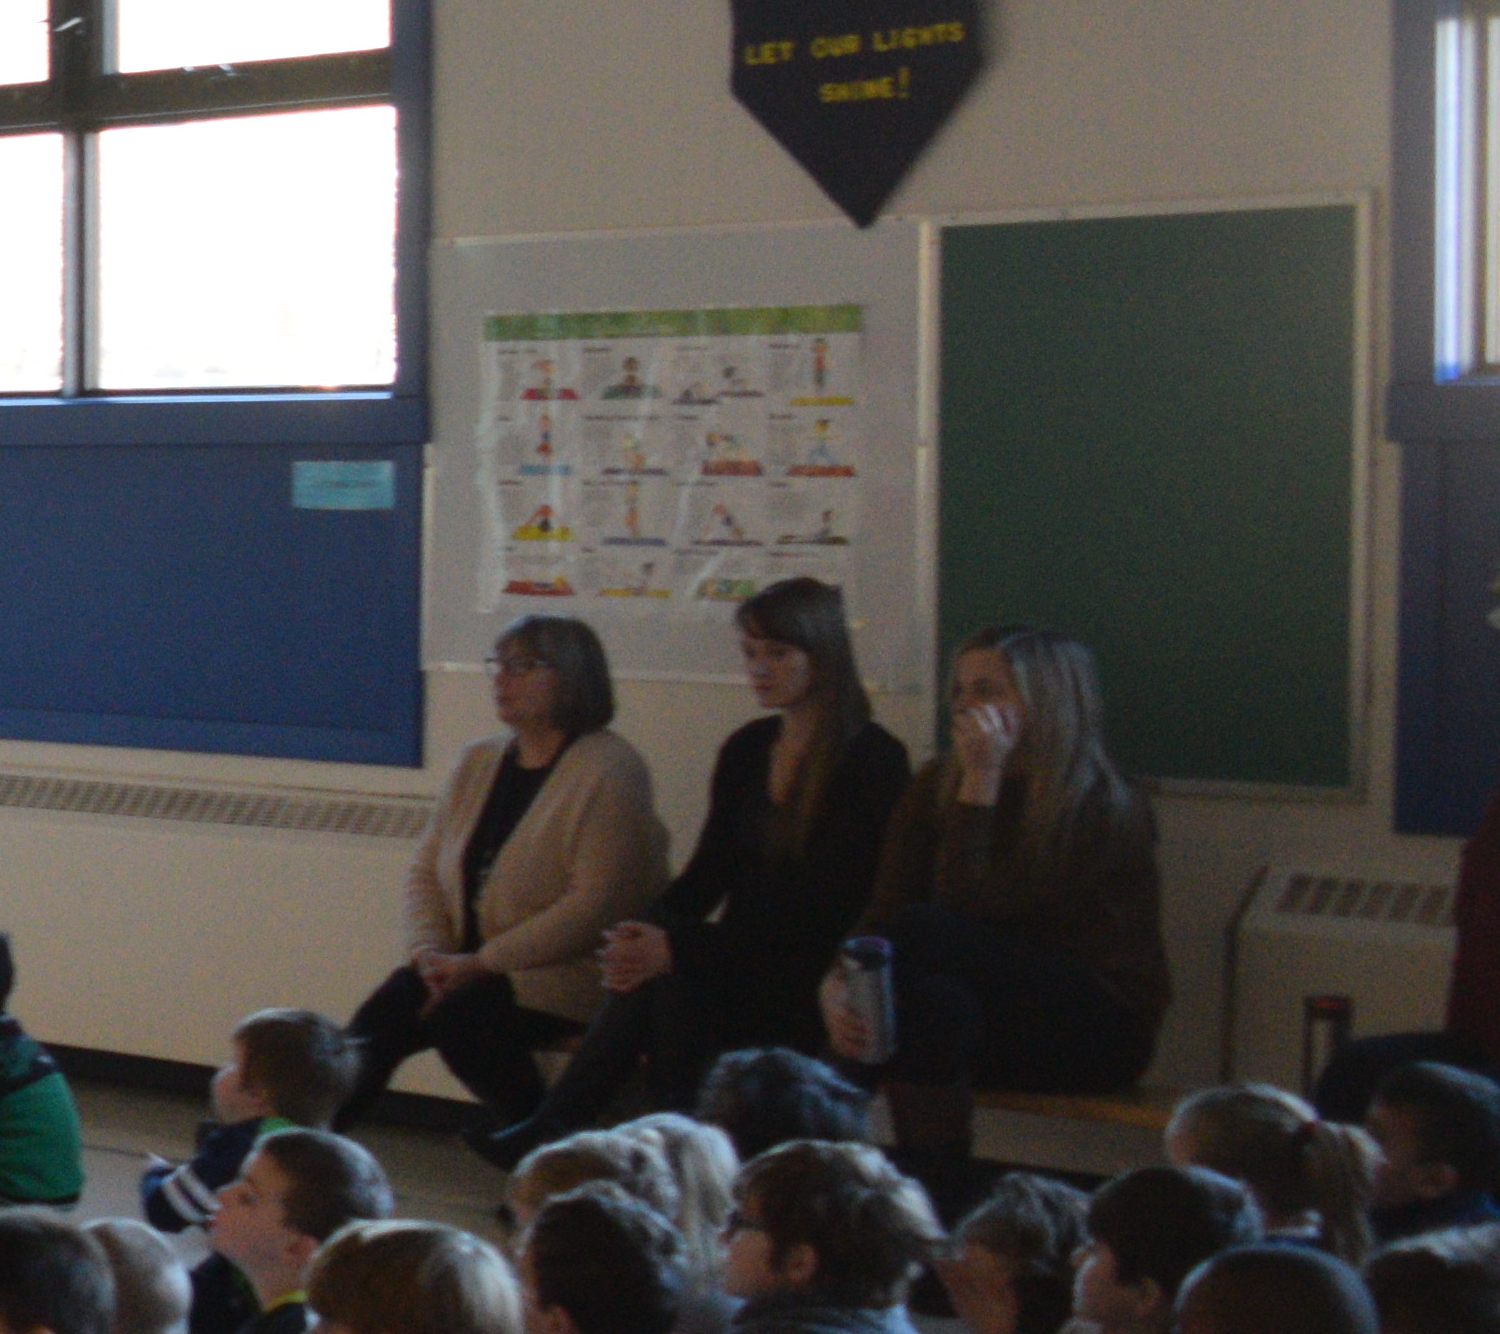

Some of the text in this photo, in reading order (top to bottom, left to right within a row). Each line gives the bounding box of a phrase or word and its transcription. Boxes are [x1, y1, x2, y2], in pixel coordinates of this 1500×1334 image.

[744, 21, 965, 66] LET OUR LIGHTS
